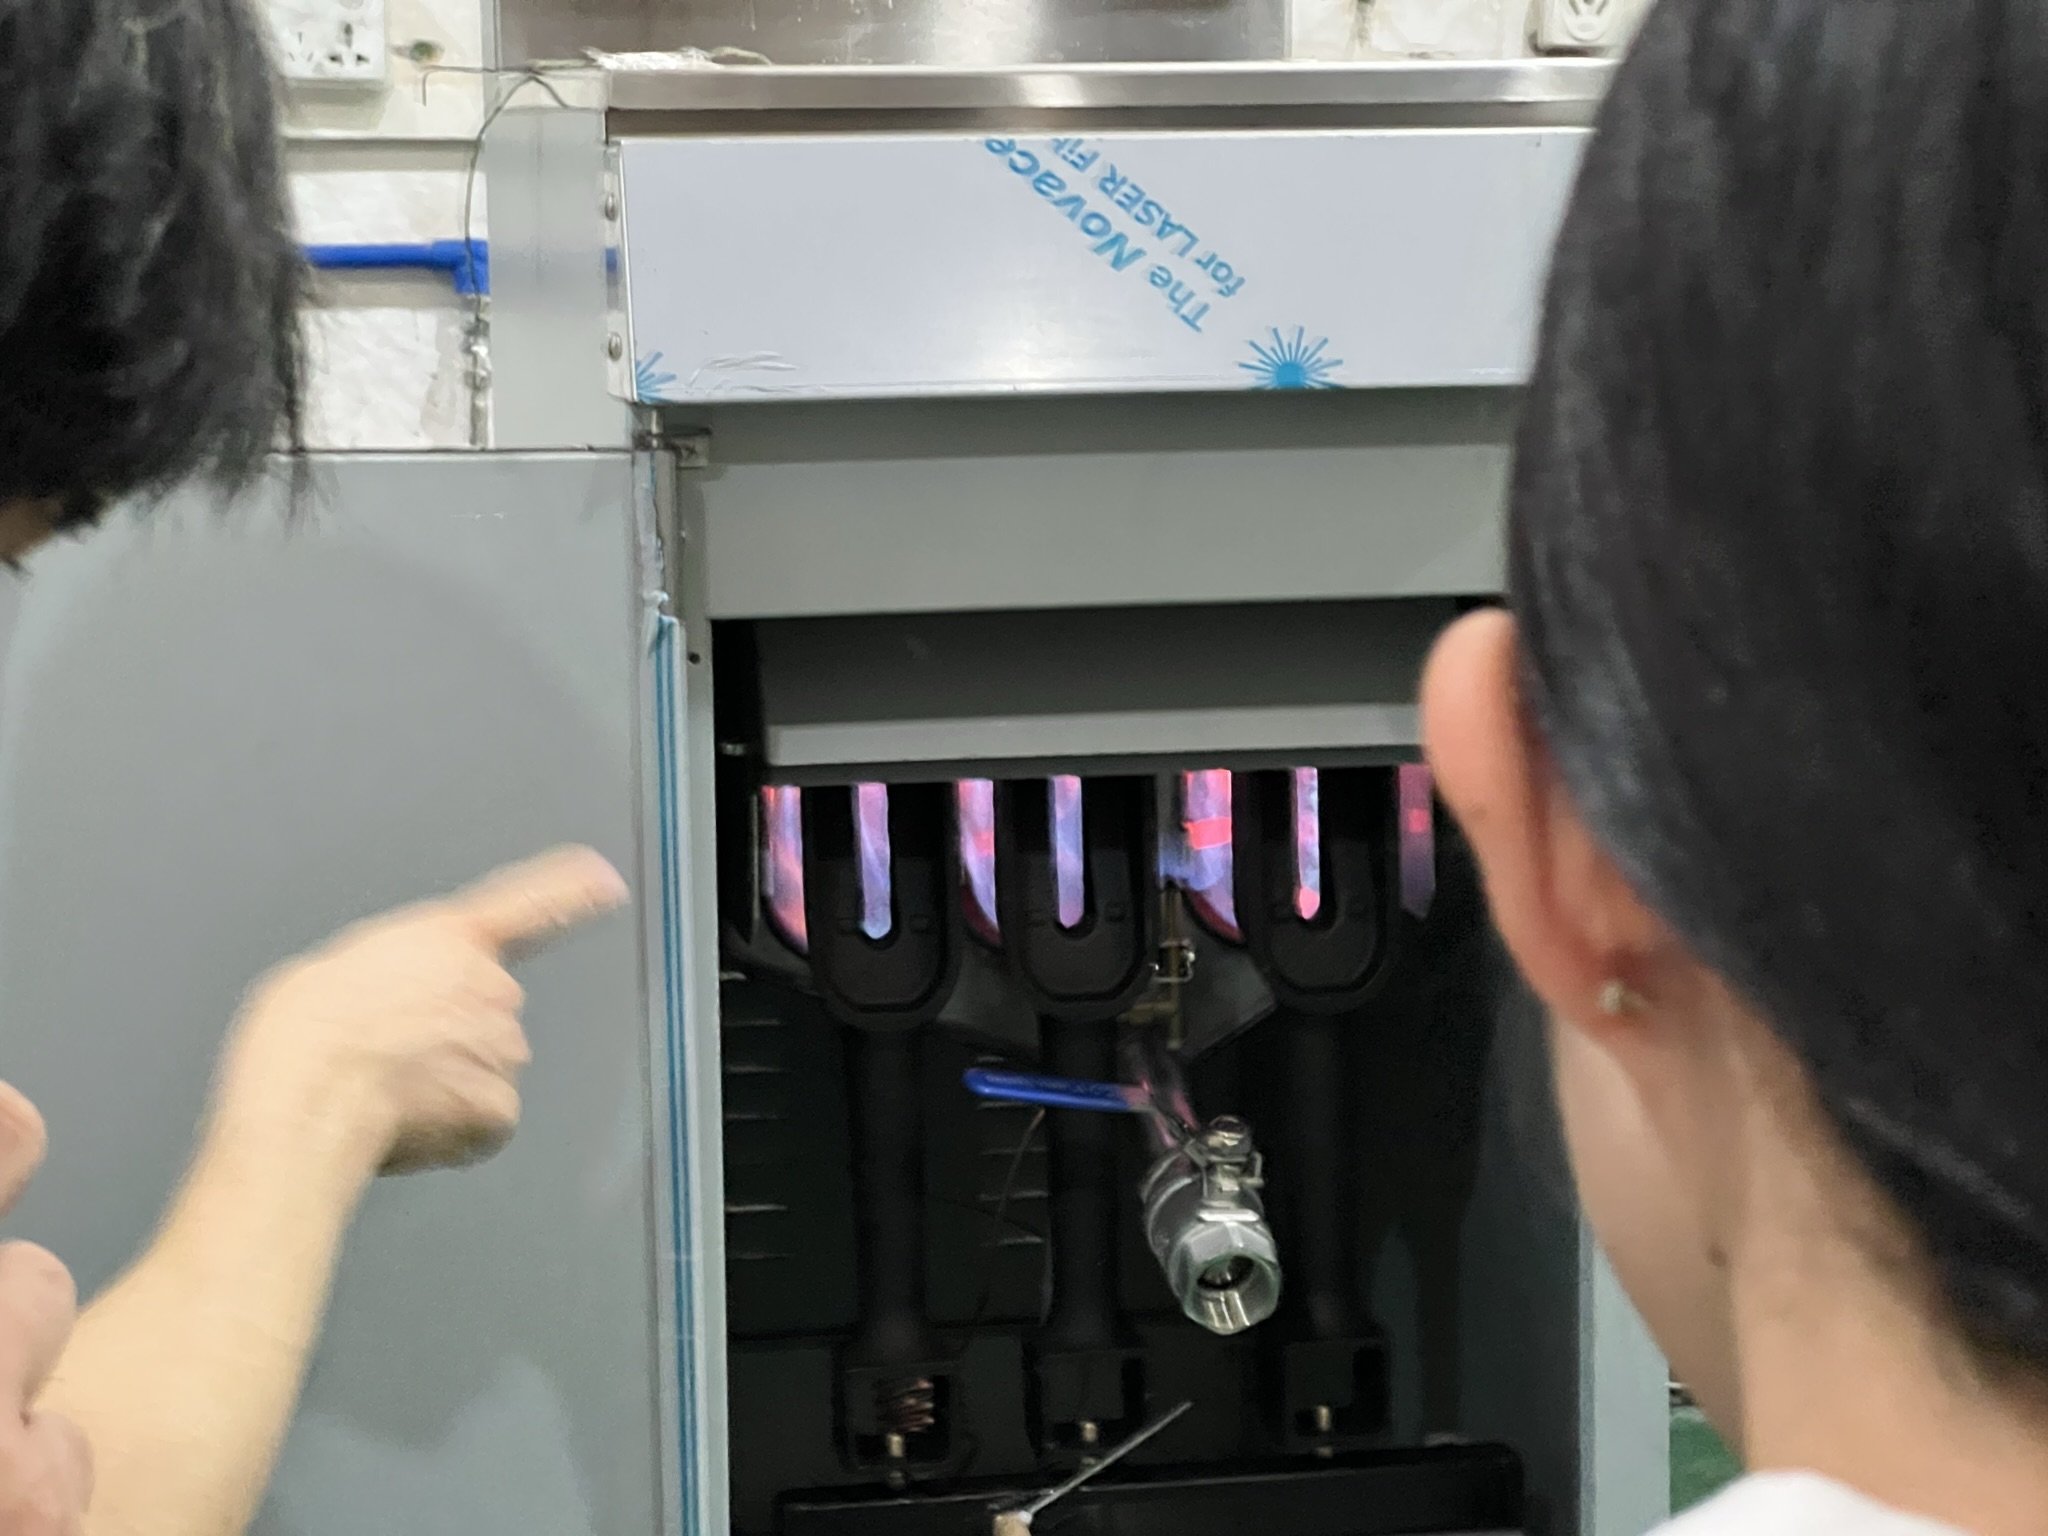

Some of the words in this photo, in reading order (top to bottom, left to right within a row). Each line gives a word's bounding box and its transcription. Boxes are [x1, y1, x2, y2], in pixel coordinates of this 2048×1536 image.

[1098, 164, 1199, 257] LASER
[1149, 265, 1210, 332] The
[1195, 252, 1245, 298] for
